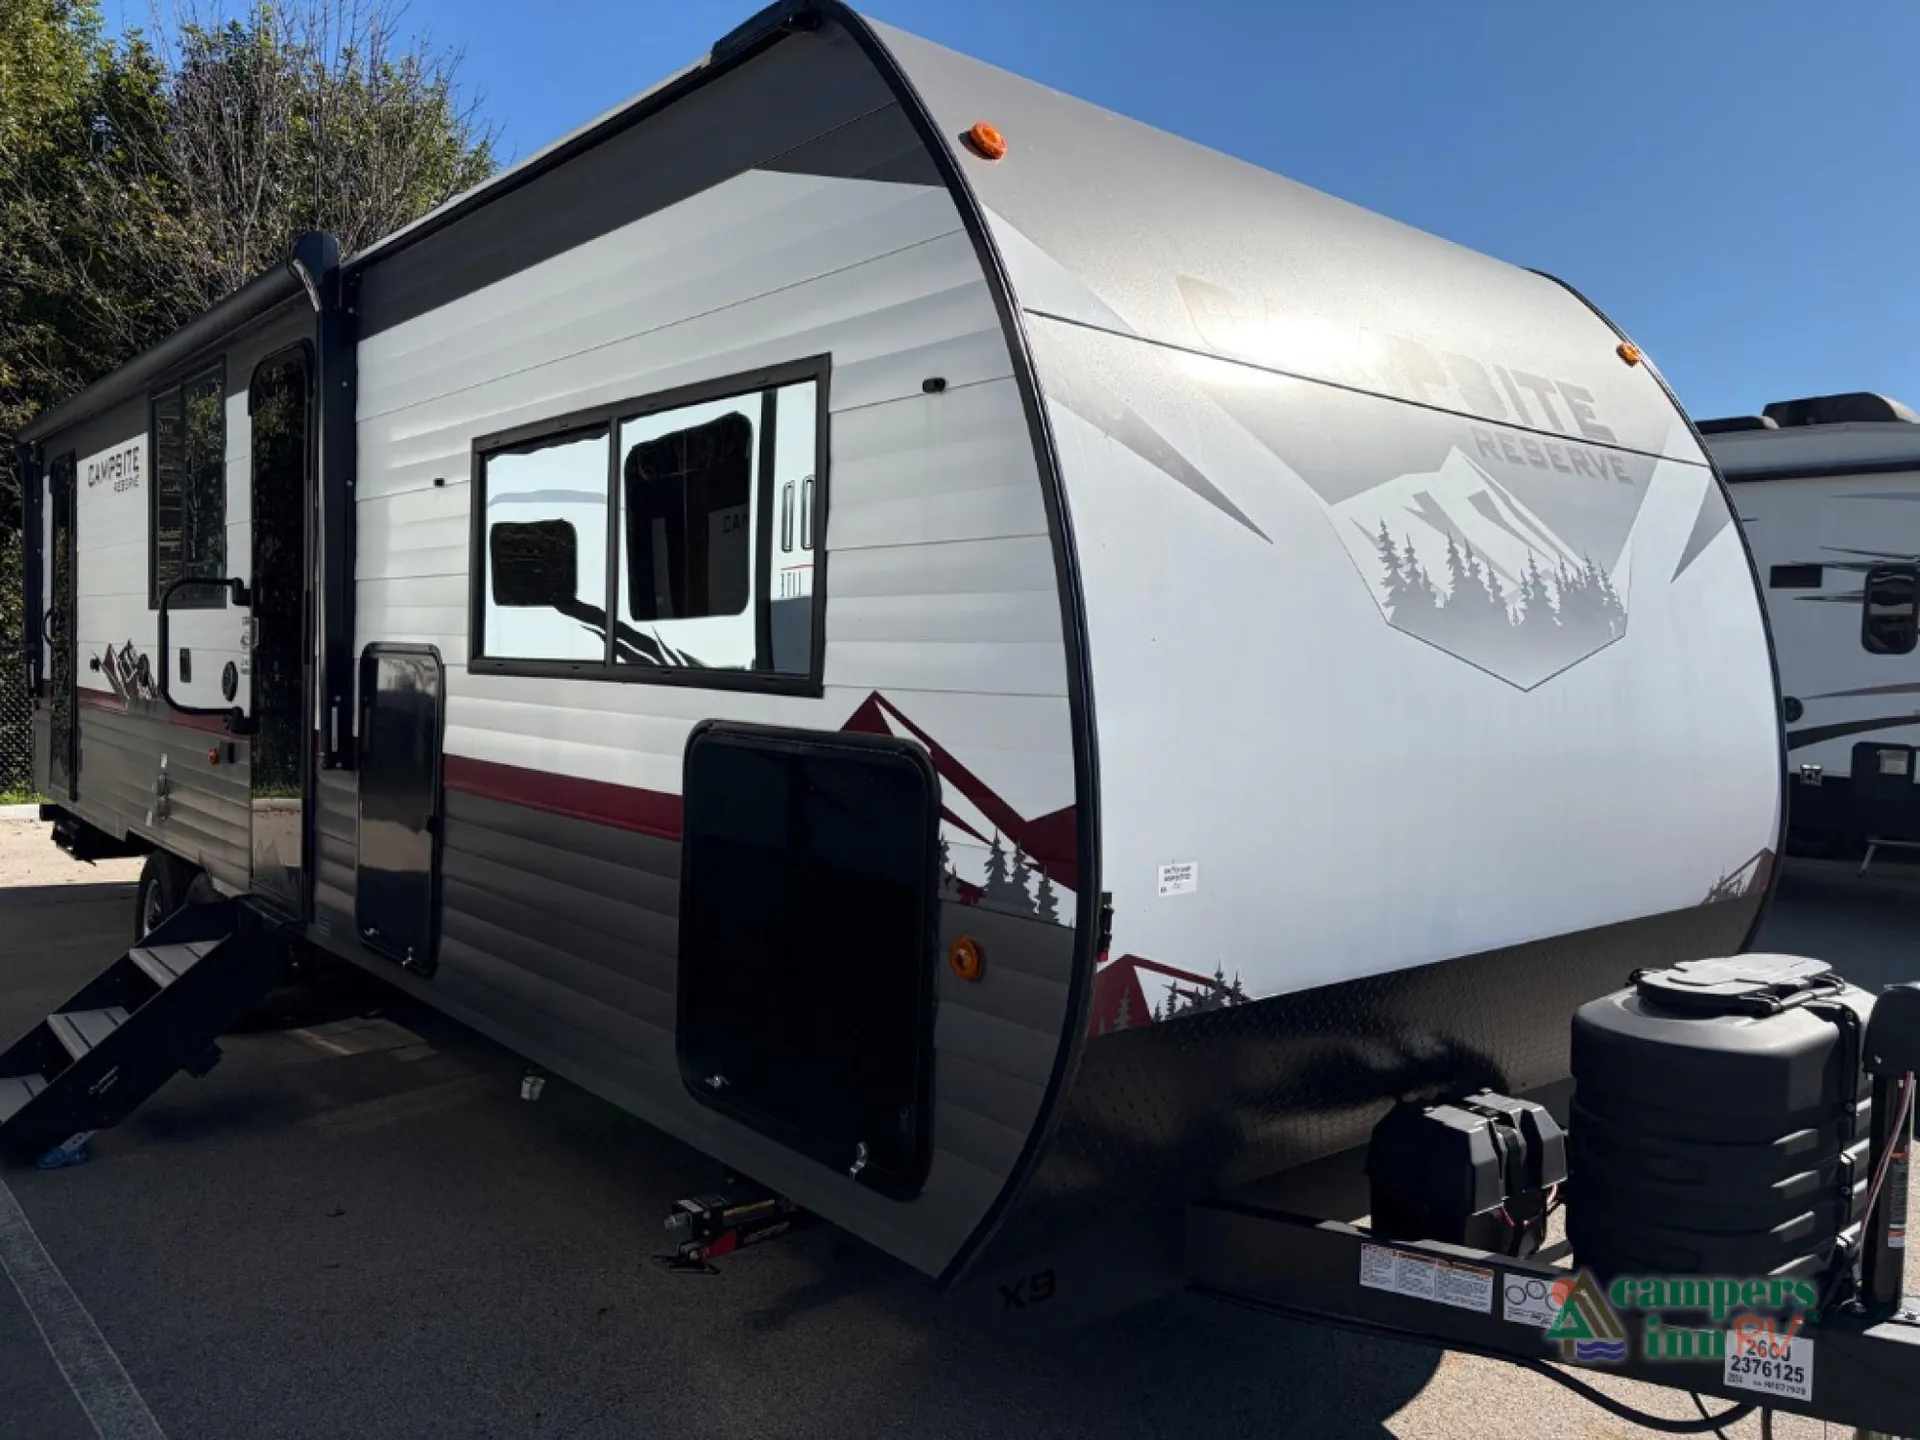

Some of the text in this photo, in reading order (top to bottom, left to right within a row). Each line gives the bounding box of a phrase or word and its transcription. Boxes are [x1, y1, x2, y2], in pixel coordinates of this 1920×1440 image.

[88, 446, 139, 488] CAMPSITE
[1469, 424, 1634, 486] RESERVE
[1730, 1355, 1804, 1383] 2376125
